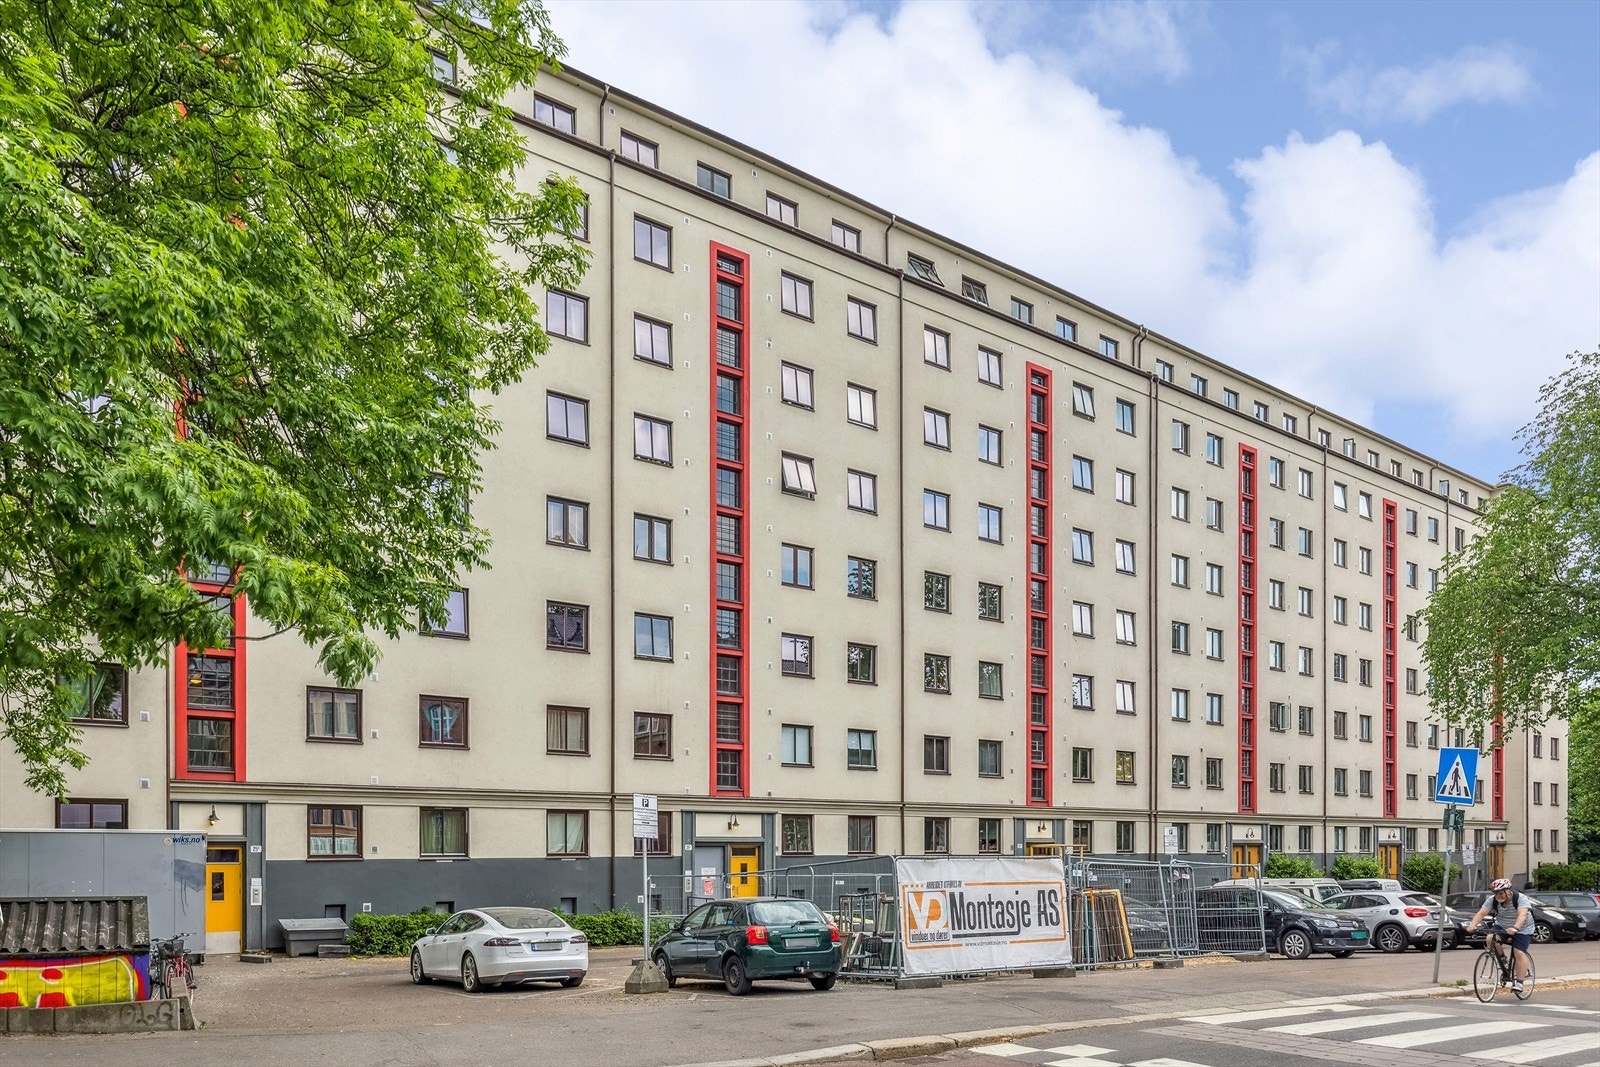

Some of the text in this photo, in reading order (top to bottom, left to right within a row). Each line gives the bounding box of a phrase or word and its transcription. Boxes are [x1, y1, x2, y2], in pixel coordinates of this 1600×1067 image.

[172, 836, 201, 844] wiks.no
[949, 889, 1061, 936] Montasje AS
[929, 932, 936, 942] og
